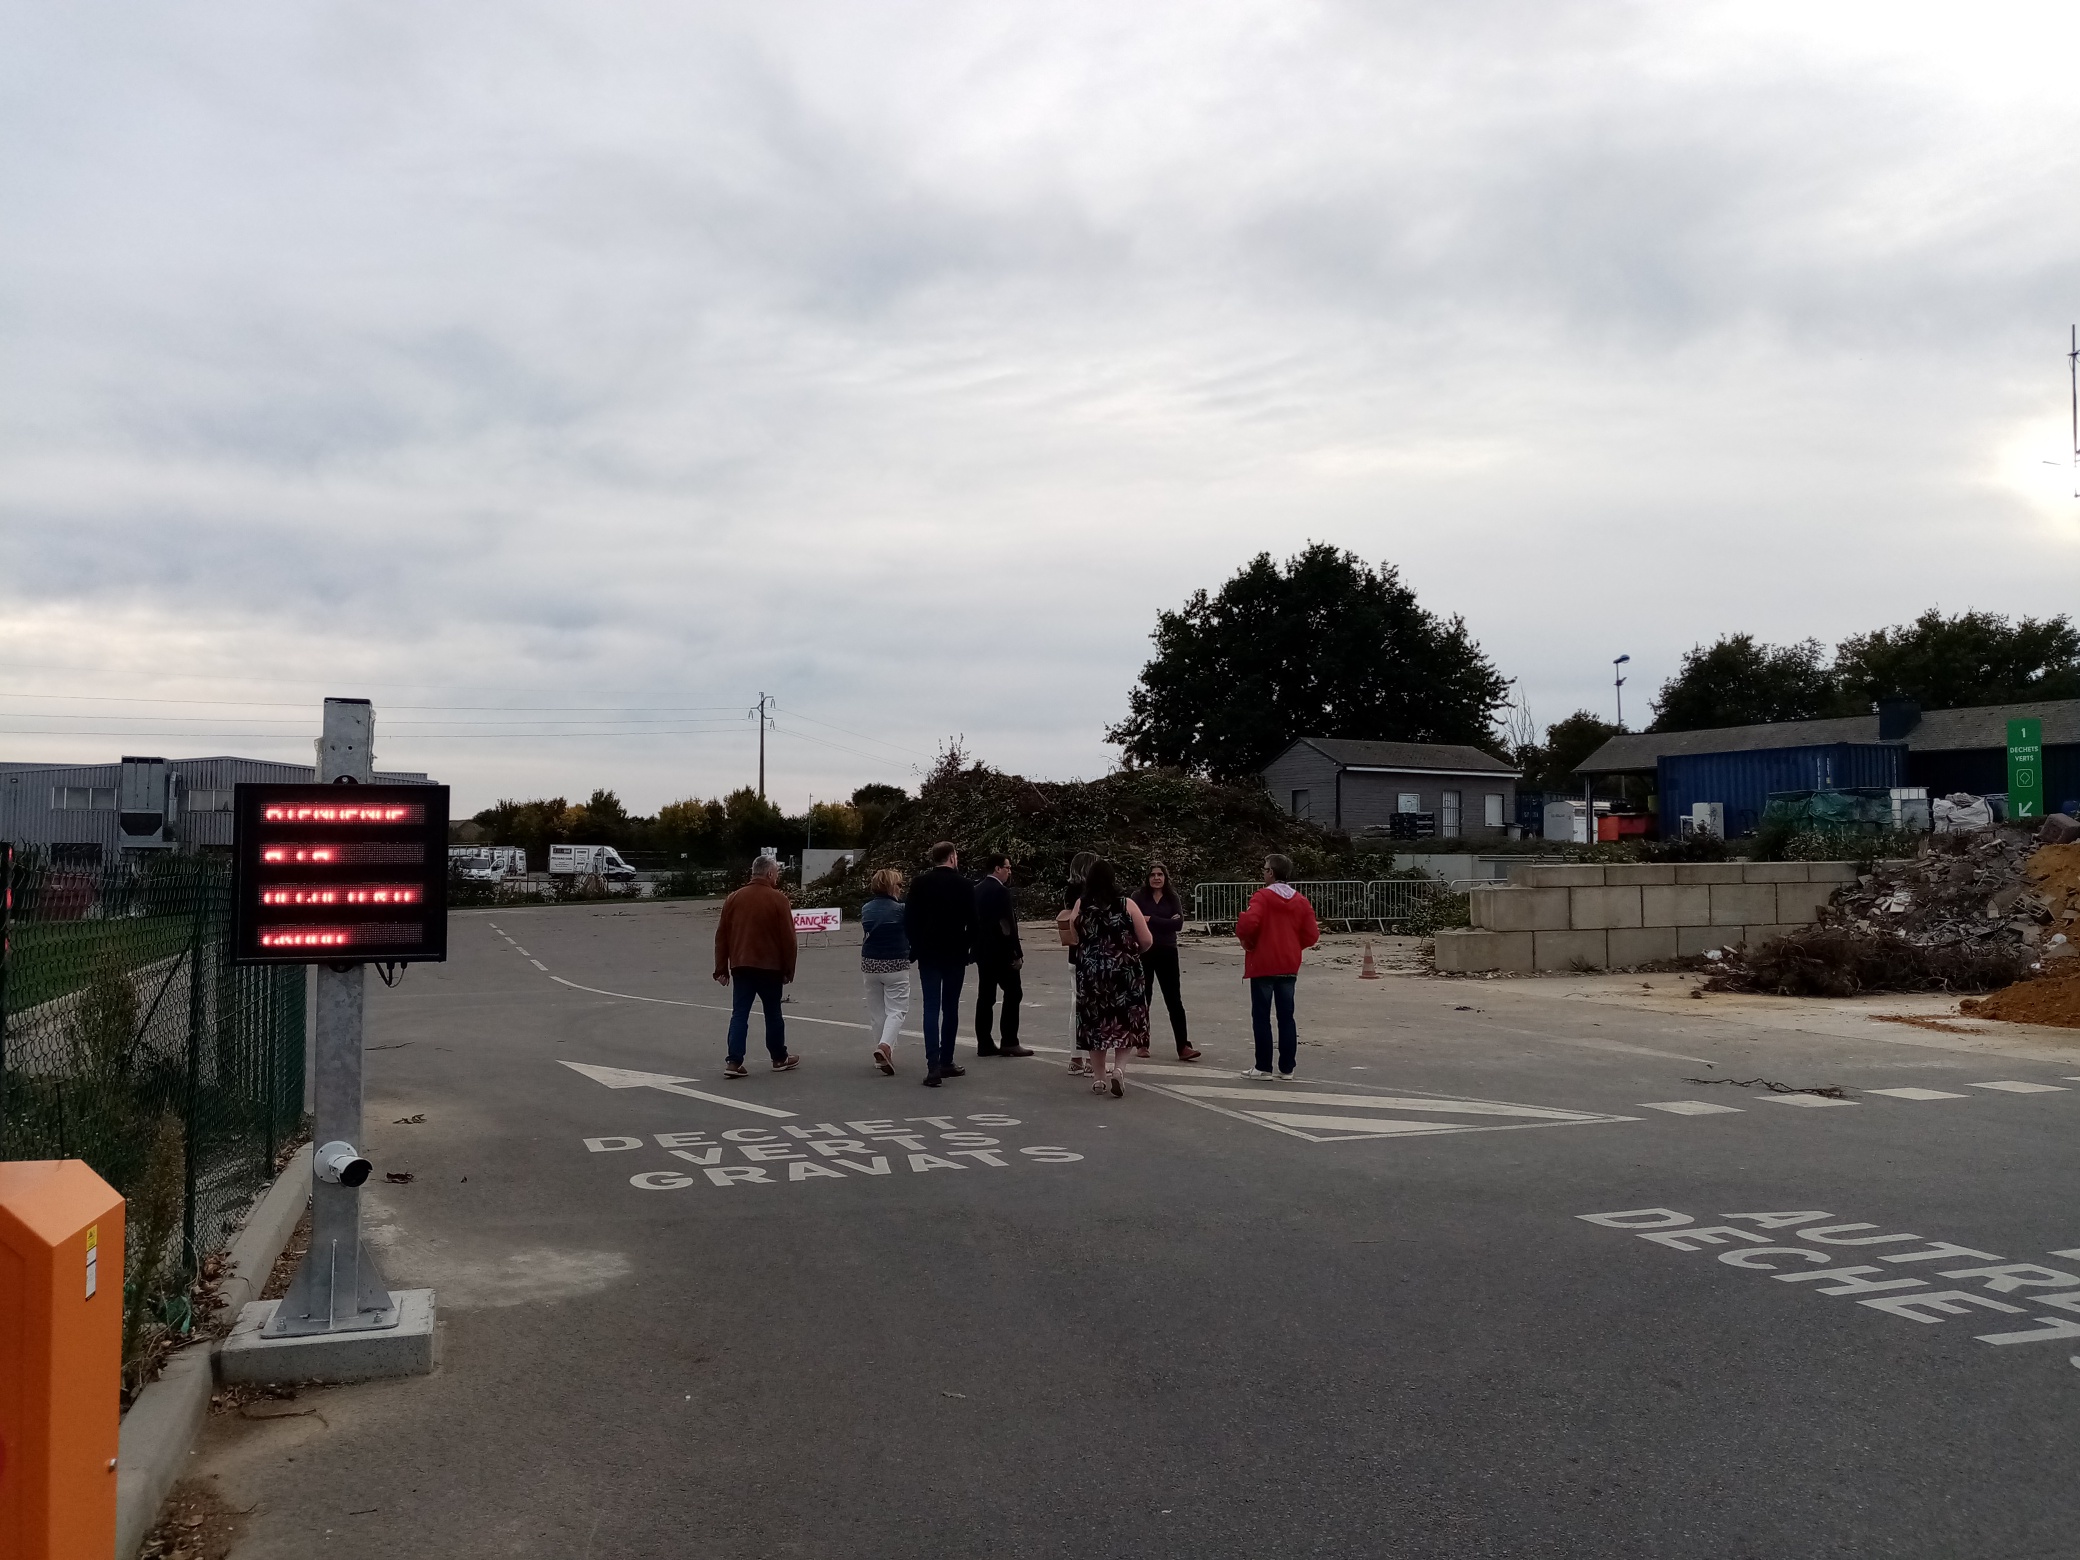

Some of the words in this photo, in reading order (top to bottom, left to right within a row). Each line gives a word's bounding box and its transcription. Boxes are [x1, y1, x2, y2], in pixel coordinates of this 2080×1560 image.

[2021, 727, 2026, 738] 1
[2015, 754, 2034, 762] VERTS
[793, 914, 839, 926] RANCHES
[582, 1113, 1022, 1153] DECHETS
[668, 1131, 1001, 1165] VERTS
[629, 1145, 1085, 1191] GRAVATS
[1574, 1207, 2080, 1370] DECHET
